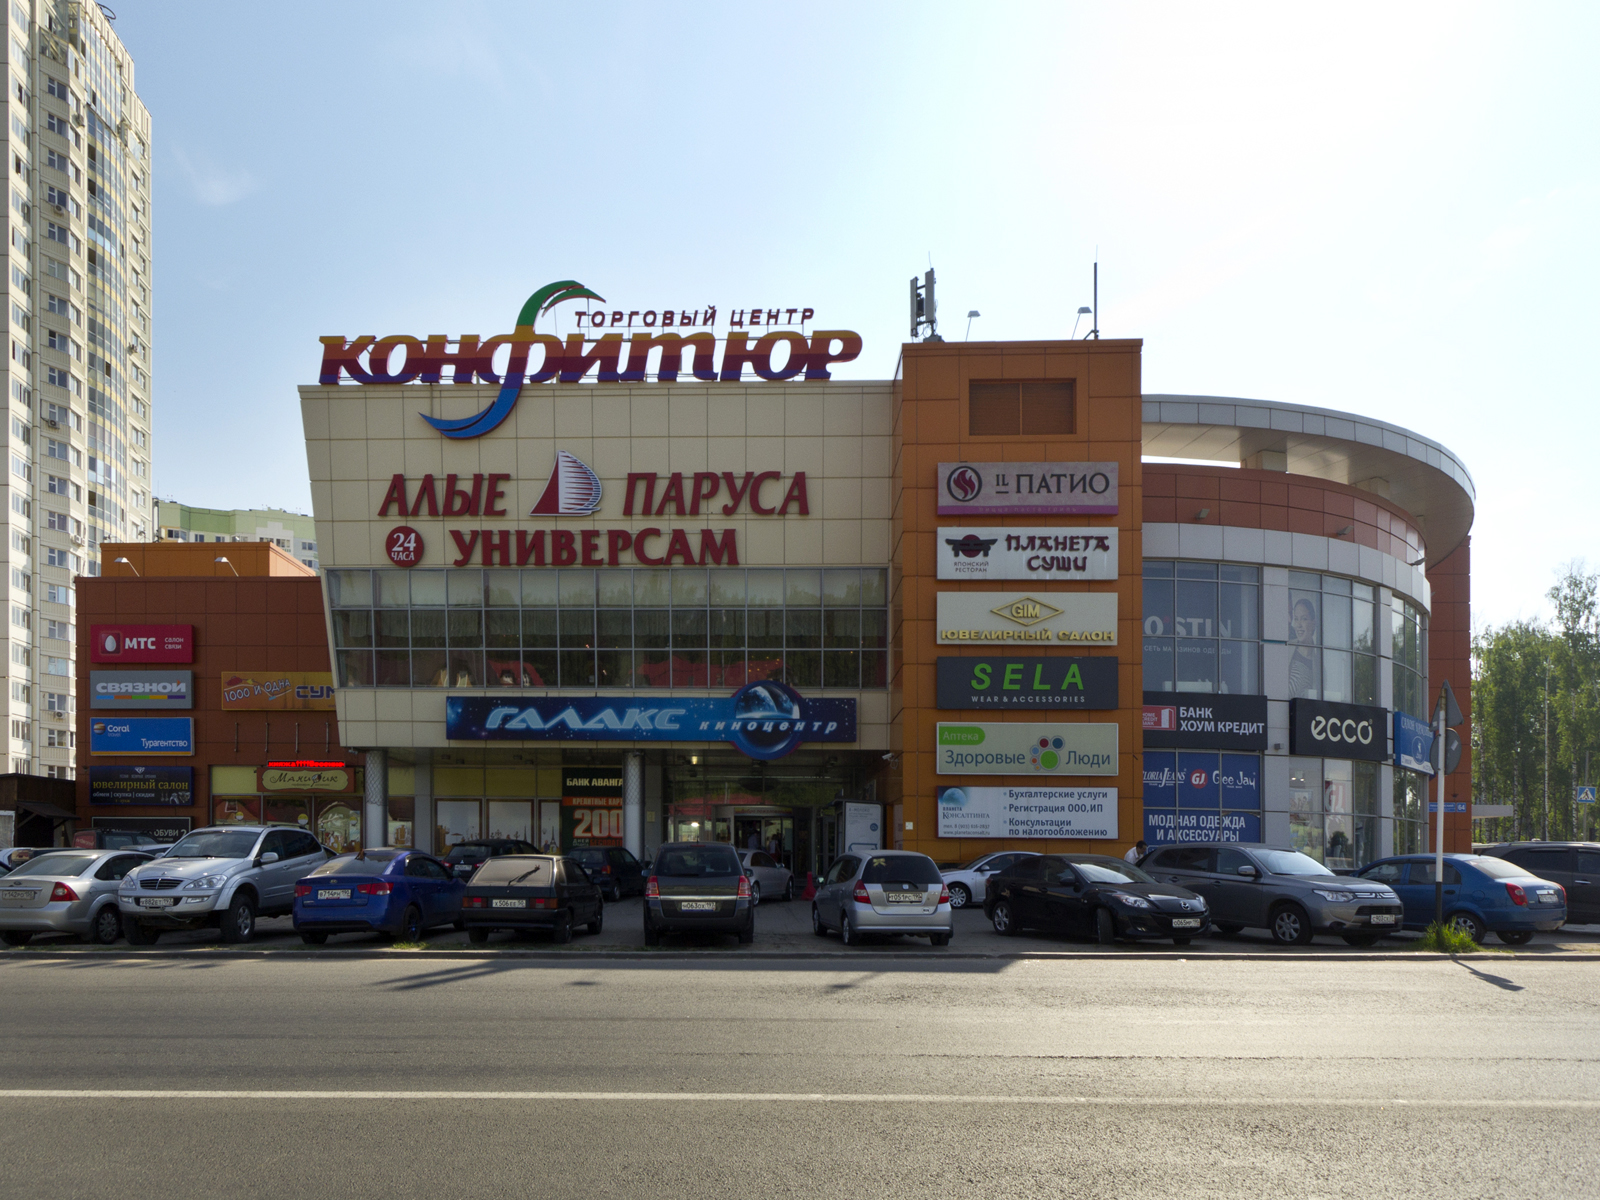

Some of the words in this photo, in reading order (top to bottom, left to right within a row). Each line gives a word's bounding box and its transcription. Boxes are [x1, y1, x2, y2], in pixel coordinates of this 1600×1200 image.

[575, 305, 716, 327] ТОРГОВЫЙ
[730, 307, 815, 327] ЦЕНТР
[996, 474, 1009, 487] IL
[1015, 472, 1110, 494] ПАТИО
[378, 473, 511, 516] АЛЫЕ
[622, 471, 810, 516] ПАРУСА
[391, 532, 416, 551] 24
[448, 527, 740, 567] УНИВЕРСАМ
[1005, 534, 1110, 551] ПЛАНЕТА
[391, 551, 415, 562] ЧАСА
[1027, 555, 1087, 572] СУШИ
[1011, 604, 1040, 618] GIM
[941, 628, 1052, 641] ЮВЕЛИРНЫЙ
[1057, 630, 1115, 641] САЛОН
[125, 637, 156, 649] МТС
[970, 663, 1084, 690] SELA
[224, 688, 250, 703] 1000
[264, 679, 291, 693] ОДНА
[485, 708, 686, 730] ГАЛАКС
[1179, 707, 1213, 719] БАНК
[107, 724, 130, 733] Coral
[699, 719, 838, 735] киноцентр
[1180, 720, 1215, 732] ХОУМ
[1217, 721, 1265, 736] КРЕДИТ
[1311, 715, 1373, 745] ecco
[141, 738, 188, 749] Турагентство
[942, 732, 979, 742] Аптека
[945, 750, 1026, 767] Здоровые
[1065, 751, 1111, 768] Люди
[1143, 770, 1162, 781] LORIA
[1191, 773, 1206, 784] GJ
[1212, 770, 1234, 785] Gee
[1236, 771, 1256, 790] Jay
[93, 779, 156, 791] ювелирный
[566, 778, 590, 787] БАНК
[572, 797, 607, 805] КРЕДИТНЫЕ
[1008, 790, 1075, 801] Бухгалтерские
[1077, 791, 1107, 801] услуги
[1008, 803, 1066, 814] Регистрация
[942, 812, 990, 820] КОНСАЛТИНГА
[1008, 818, 1072, 827] Консультации
[1149, 814, 1197, 828] МОДНАЯ
[1199, 815, 1246, 830] ОДЕЖДА
[1022, 828, 1108, 837] налогообложению
[1156, 829, 1164, 840] И
[1167, 829, 1239, 842] АКСЕССУАРЫ
